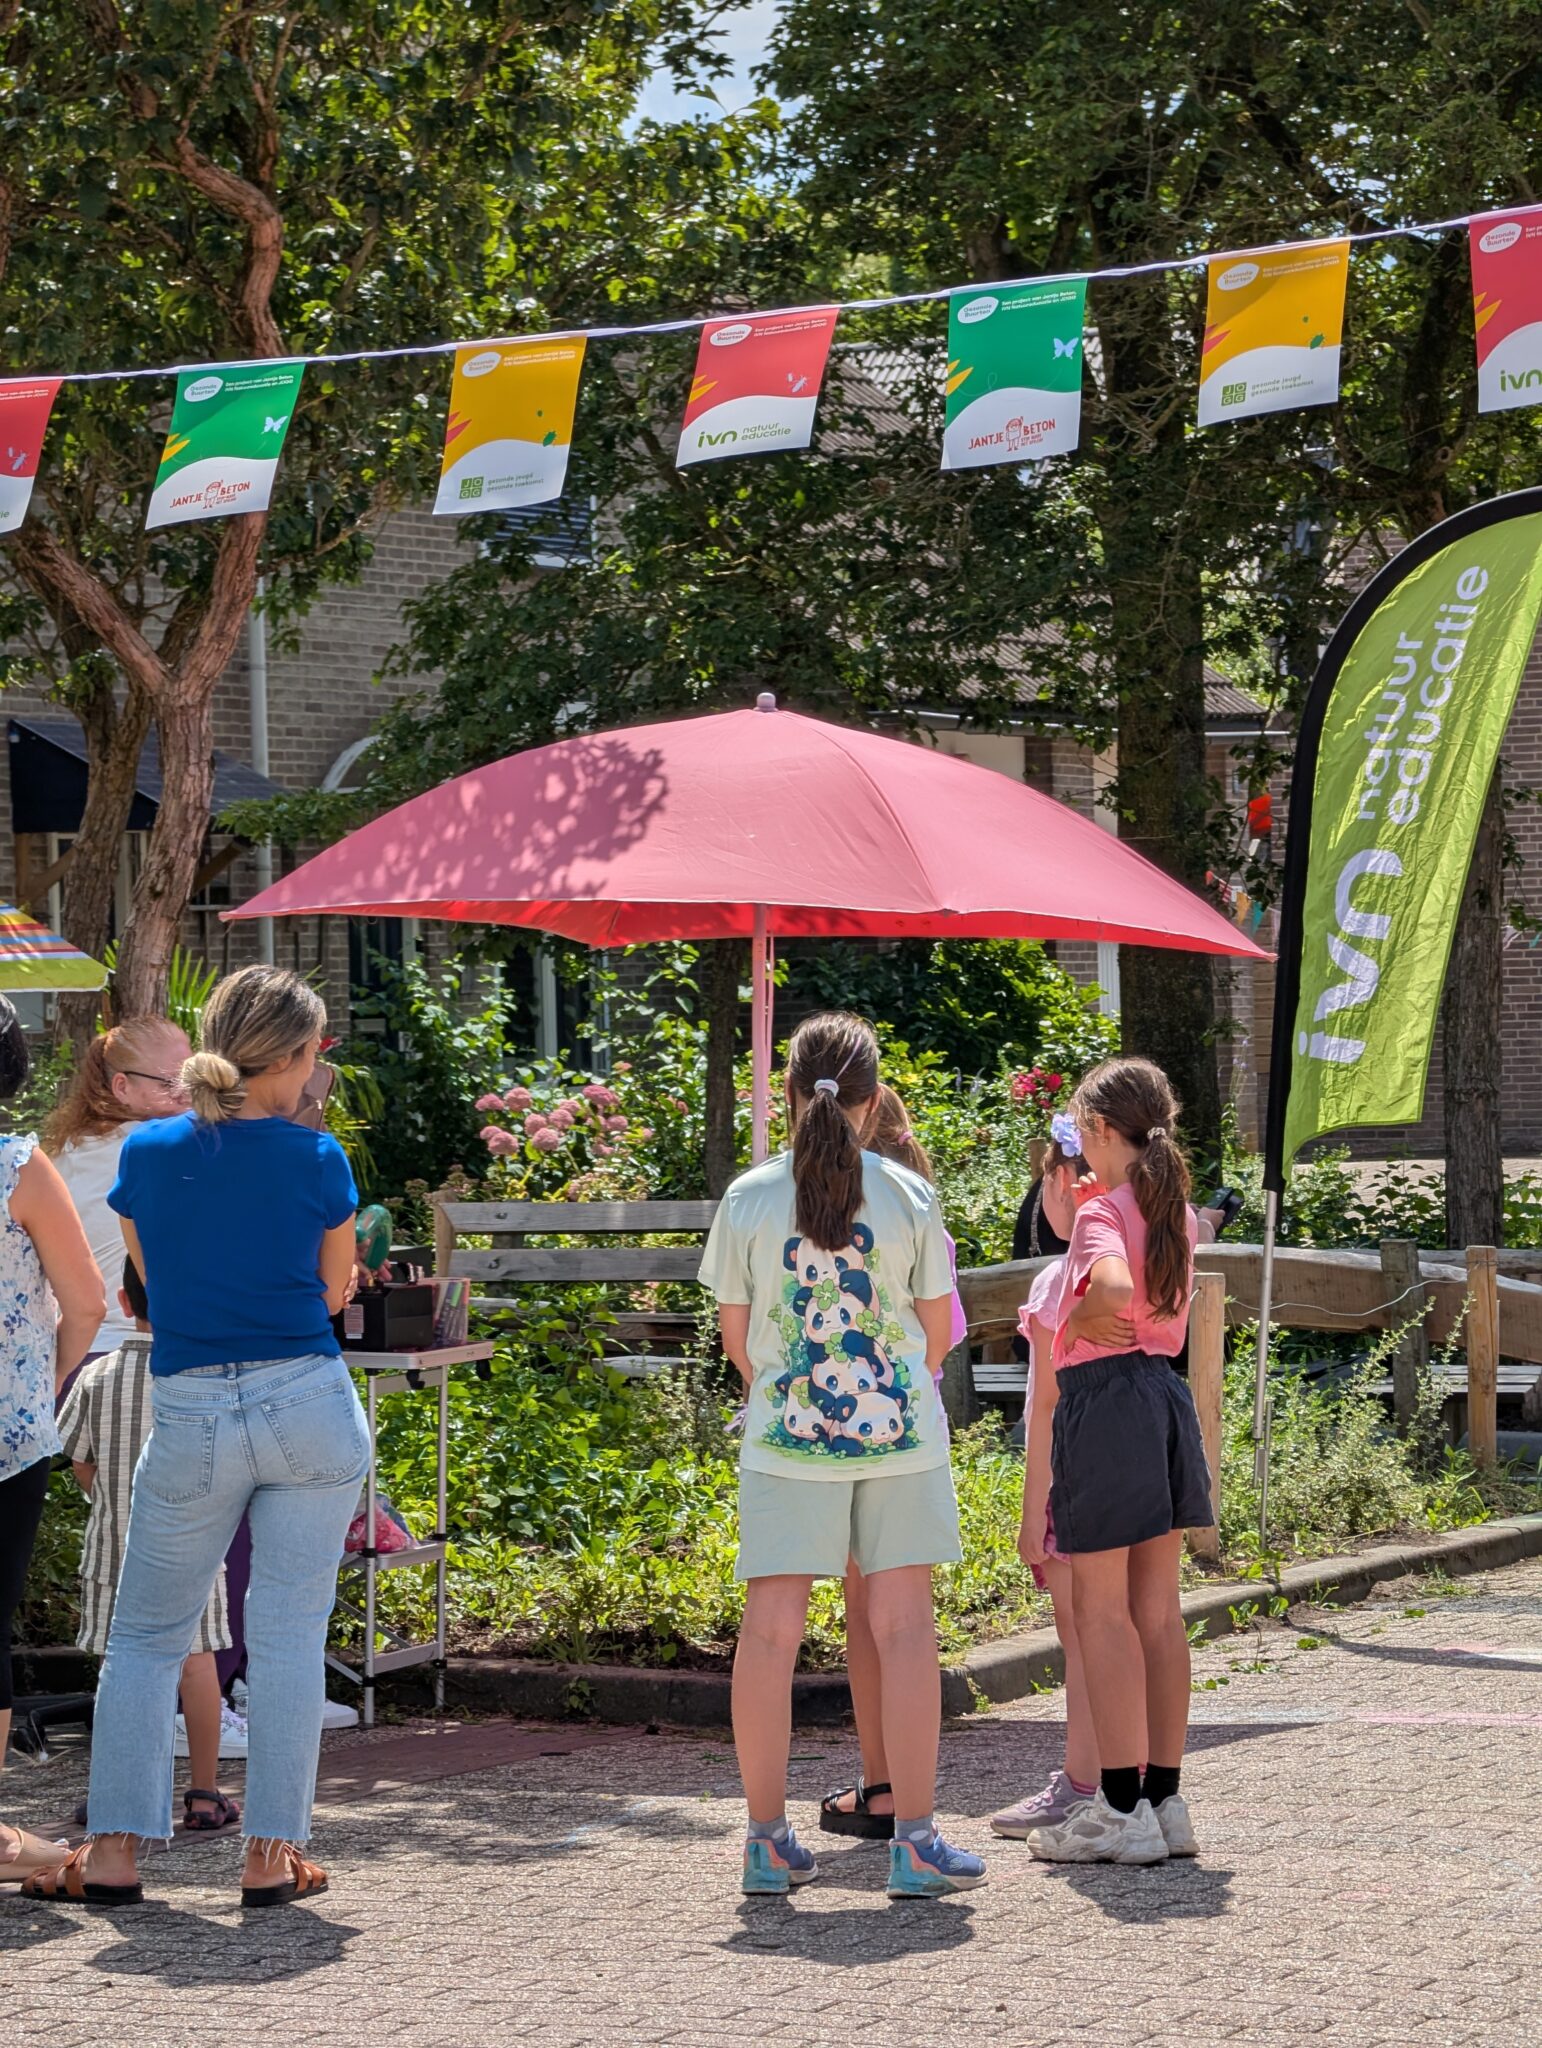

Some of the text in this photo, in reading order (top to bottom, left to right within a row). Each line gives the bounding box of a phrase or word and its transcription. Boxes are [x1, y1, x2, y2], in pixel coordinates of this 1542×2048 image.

[1500, 369, 1542, 392] ivn
[697, 422, 779, 448] ivn natuur
[741, 428, 791, 440] educatie
[968, 432, 1004, 450] JANTJE
[1023, 418, 1056, 436] BETON
[170, 492, 203, 508] JANTJE
[220, 481, 250, 496] BETON
[1387, 566, 1489, 825] educatie
[1358, 632, 1424, 820] natuur
[1298, 848, 1404, 1064] ivn
